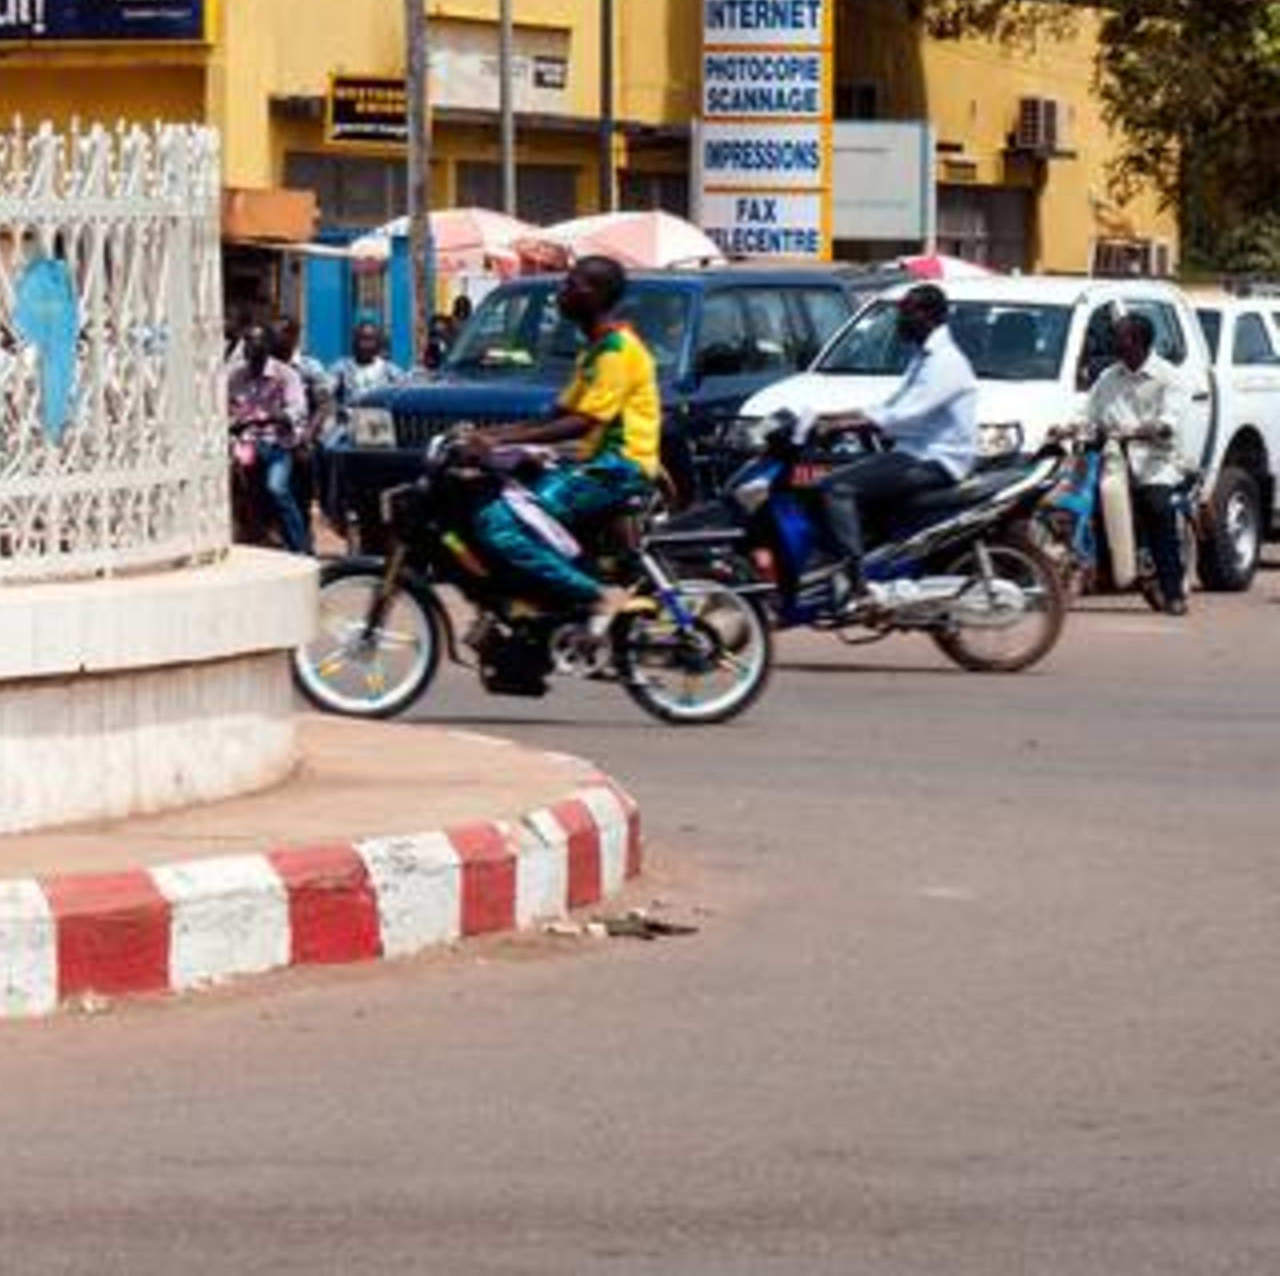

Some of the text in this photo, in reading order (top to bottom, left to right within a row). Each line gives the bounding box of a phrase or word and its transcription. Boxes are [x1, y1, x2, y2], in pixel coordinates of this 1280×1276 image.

[706, 57, 819, 81] PHOTOCOPIE
[707, 87, 818, 112] SCANNAGE
[705, 140, 821, 169] IMPRESSIONS
[736, 199, 777, 222] FAX
